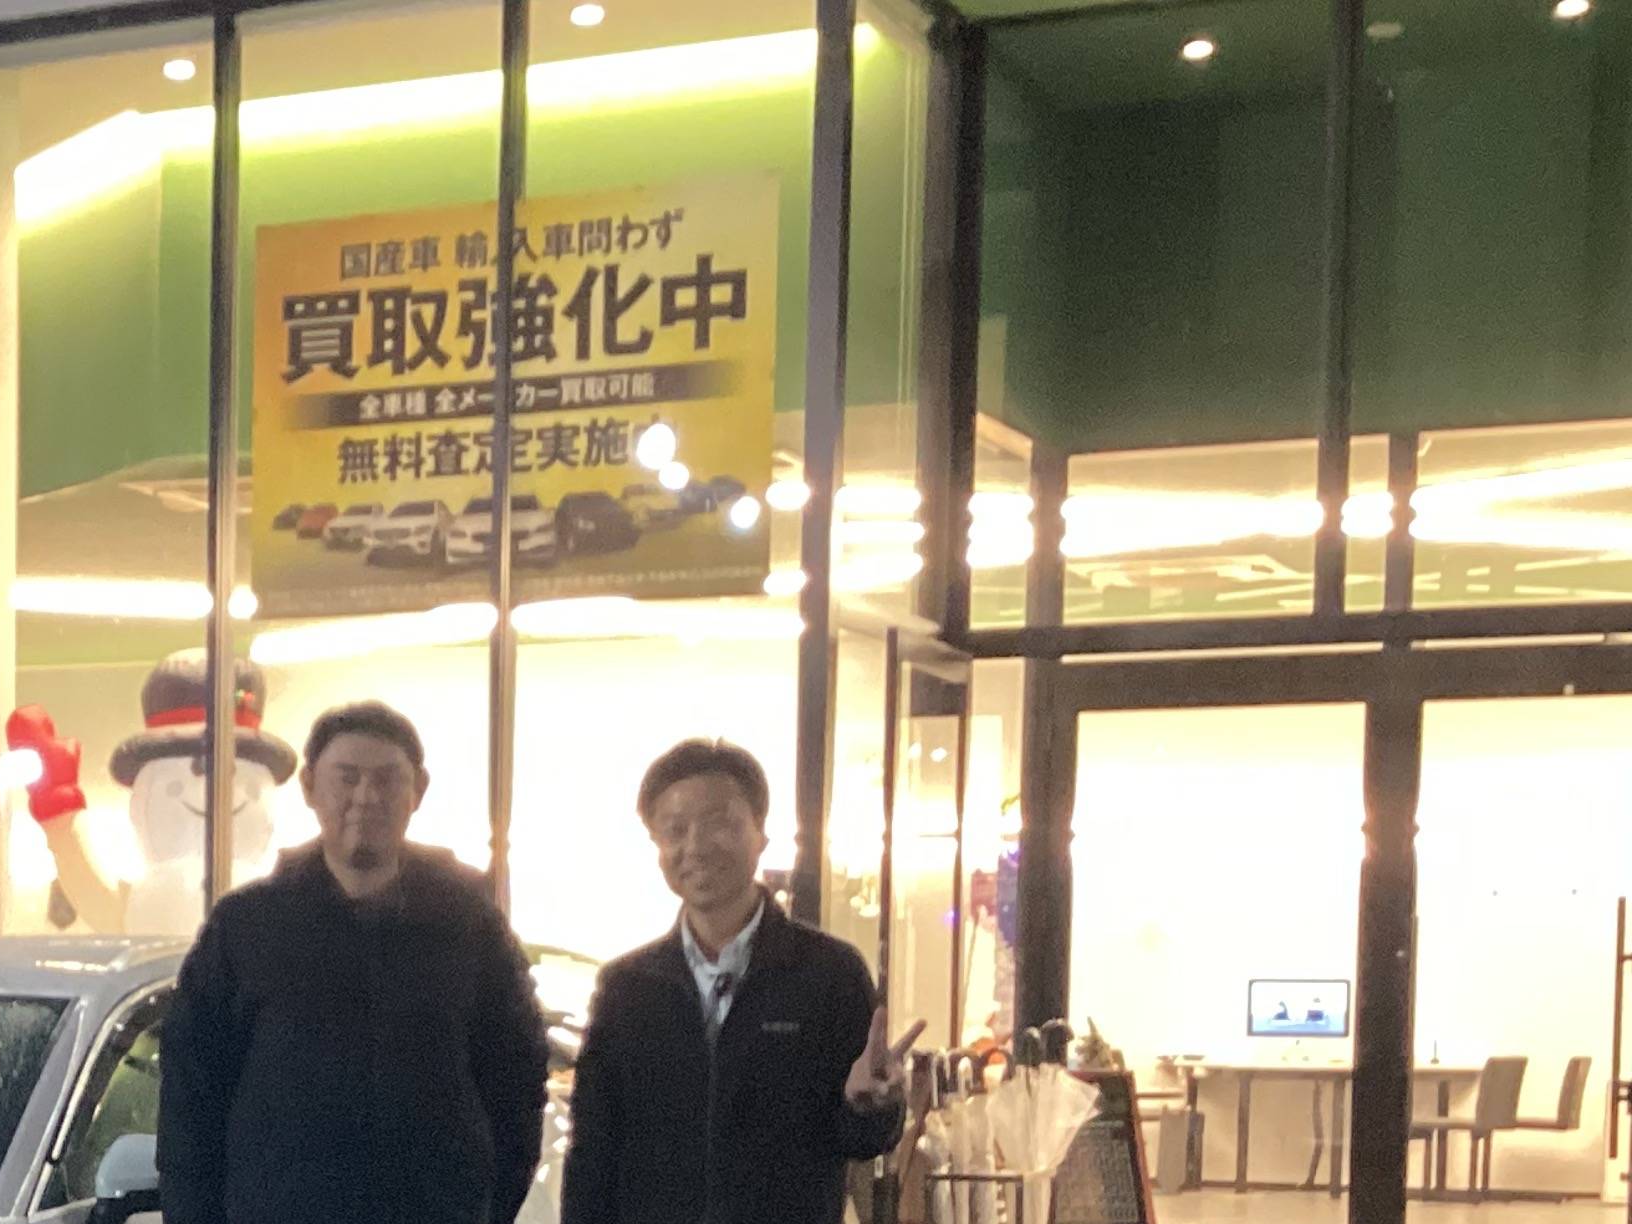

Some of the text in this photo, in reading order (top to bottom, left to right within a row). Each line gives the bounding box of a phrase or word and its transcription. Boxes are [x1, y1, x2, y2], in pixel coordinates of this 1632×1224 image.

[341, 237, 441, 280] 国産車
[282, 253, 747, 383] 買取強化中
[338, 414, 673, 484] 無料査定実施
